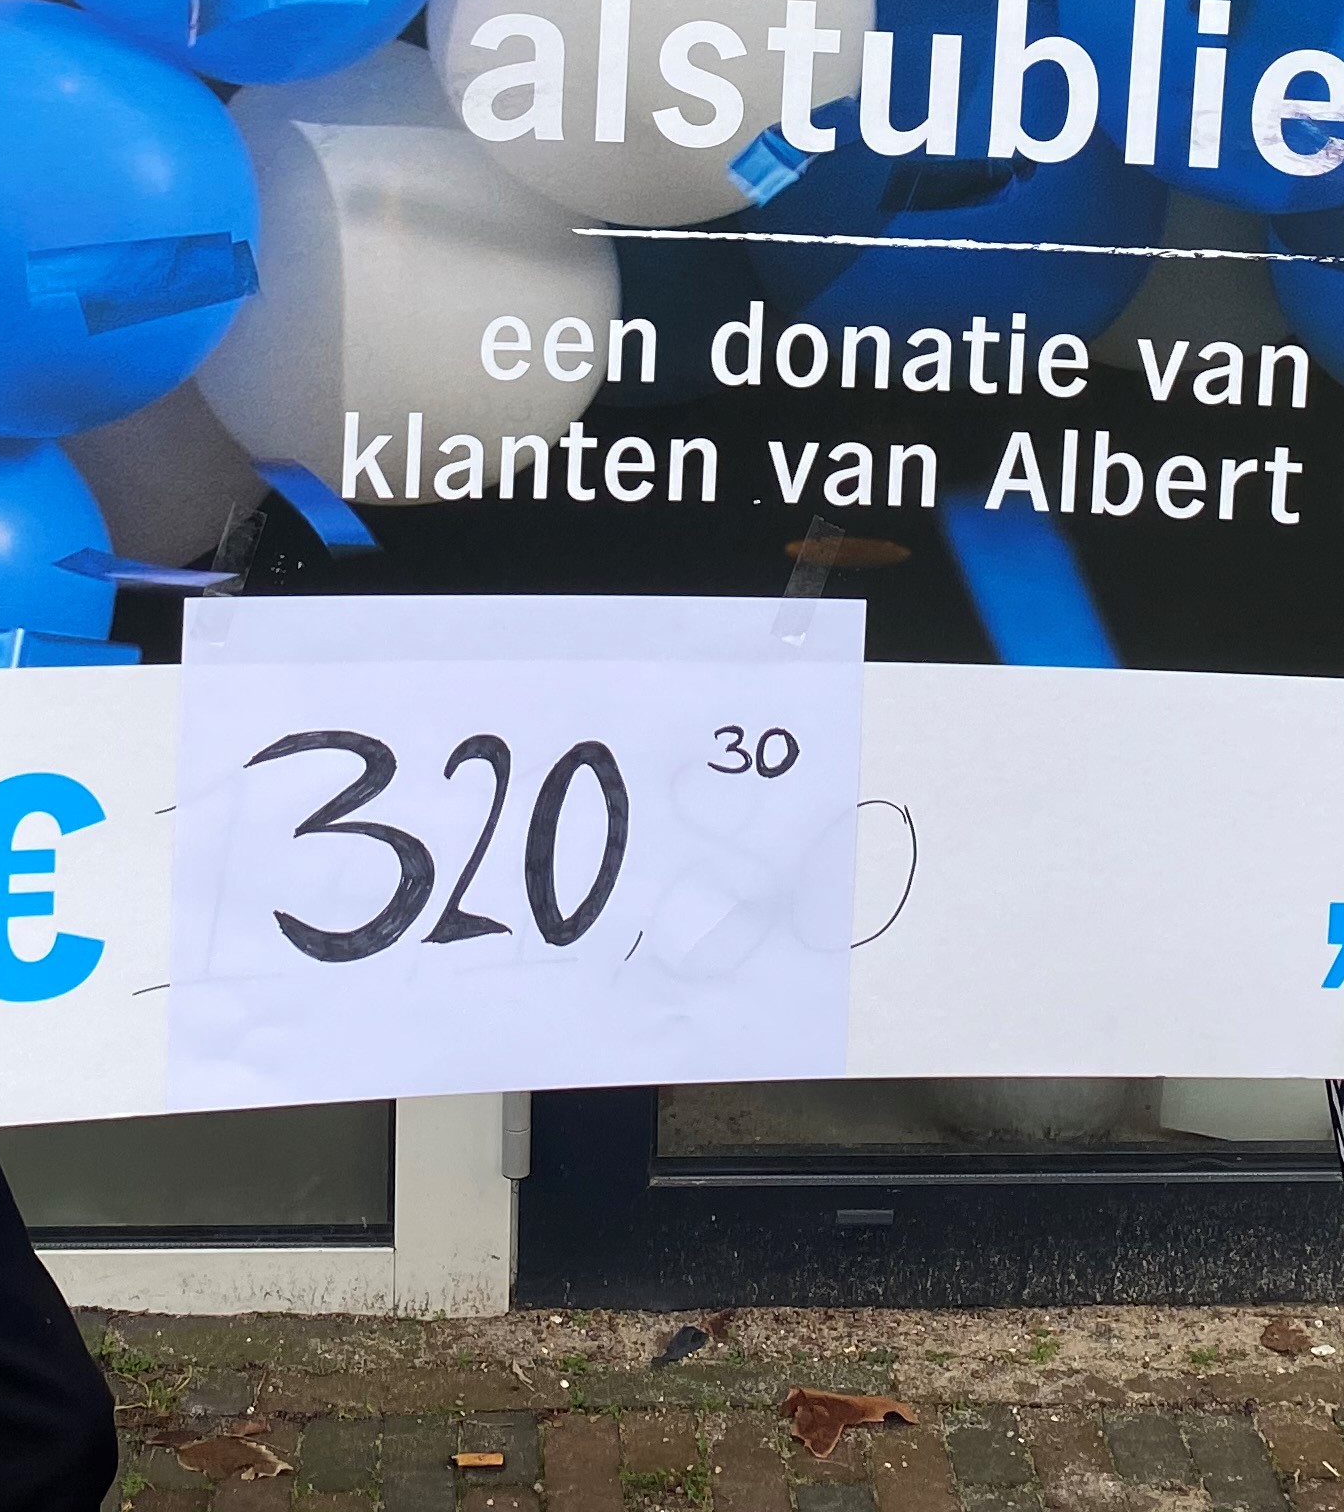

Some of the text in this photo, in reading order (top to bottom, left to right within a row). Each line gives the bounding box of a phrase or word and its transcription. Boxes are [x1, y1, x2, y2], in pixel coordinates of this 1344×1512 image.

[479, 311, 658, 385] een
[709, 300, 1091, 398] donatie
[1137, 332, 1310, 410] van
[339, 410, 720, 504] klanten
[768, 431, 938, 508] van
[984, 429, 1304, 526] Albert
[244, 724, 801, 963] 320 30
